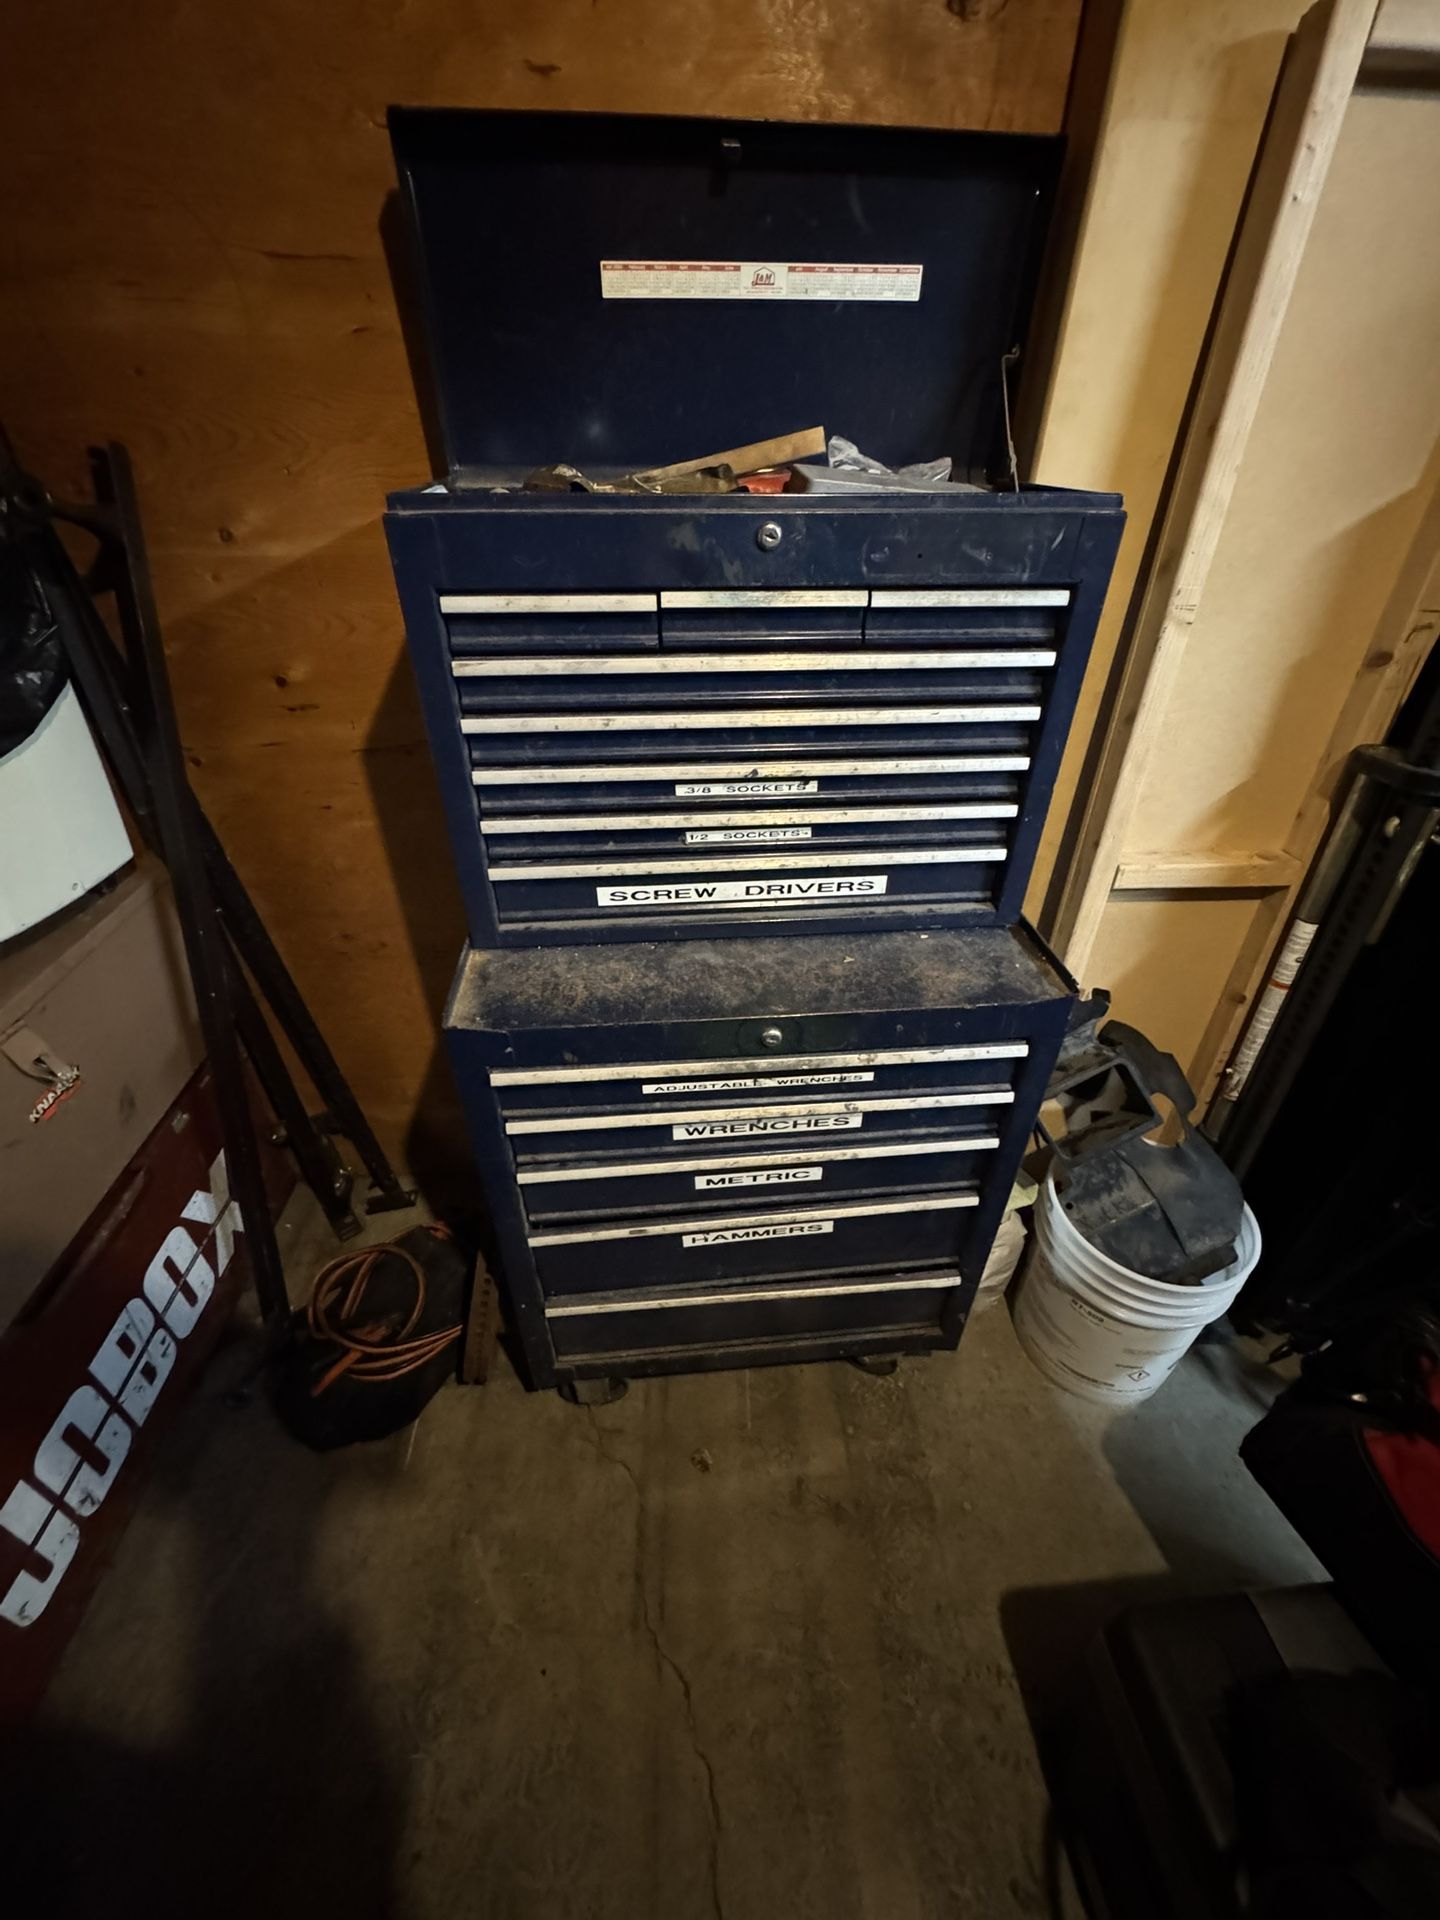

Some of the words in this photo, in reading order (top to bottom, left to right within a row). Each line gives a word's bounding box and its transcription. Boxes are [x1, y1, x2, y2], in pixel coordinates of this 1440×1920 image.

[727, 783, 806, 793] SOCKETS
[723, 829, 800, 839] SOCKETS
[609, 887, 717, 901] SCREW
[745, 880, 875, 896] DRIVERS
[654, 1078, 763, 1092] ADJUSTABLE
[777, 1074, 863, 1085] WRENCHES
[685, 1116, 850, 1136] WRENCHES
[706, 1170, 810, 1186] METRIC
[692, 1223, 823, 1244] HAMMERS
[0, 1147, 245, 1627] JOBOX
